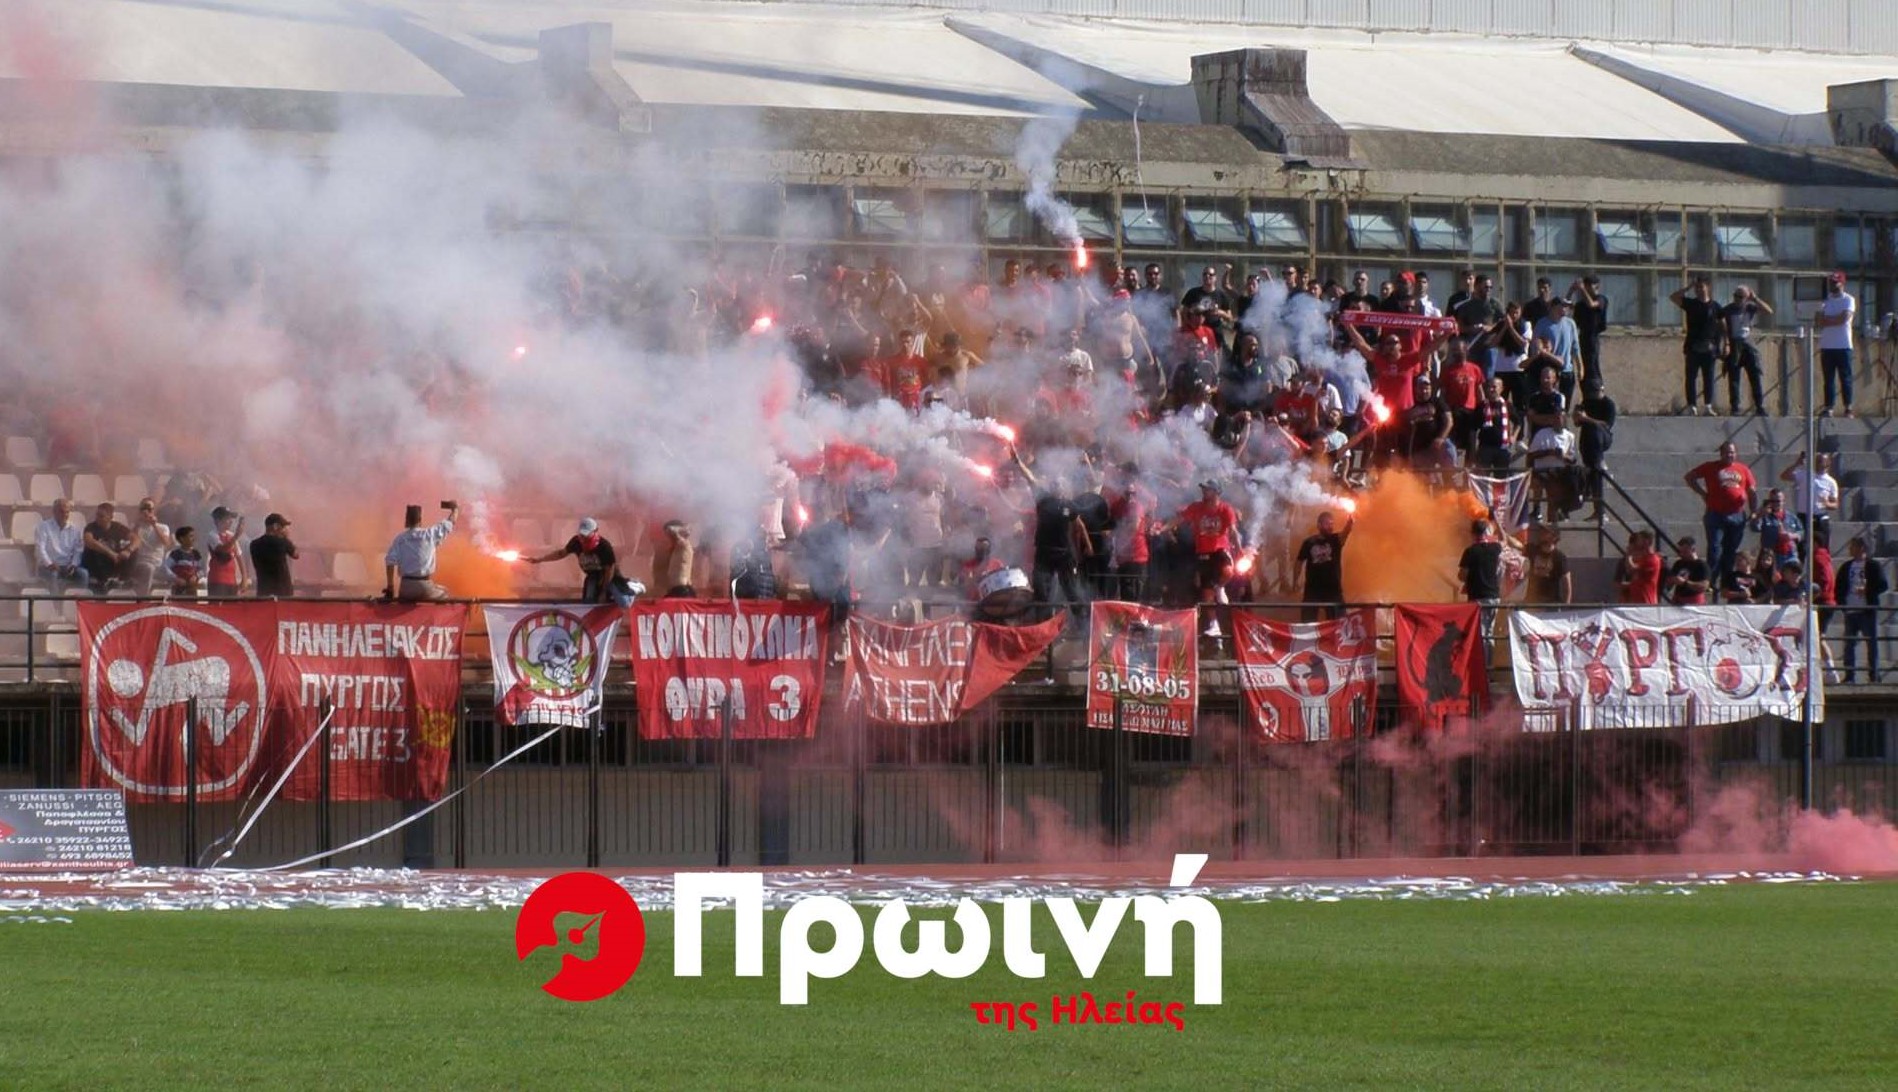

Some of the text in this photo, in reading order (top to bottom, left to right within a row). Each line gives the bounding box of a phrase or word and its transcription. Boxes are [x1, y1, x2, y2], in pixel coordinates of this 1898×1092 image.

[277, 620, 460, 660] ΠΑΝΗΛΕΙΑΚΟΣ
[301, 672, 406, 712] ΠΥΡΓΟΣ
[665, 674, 801, 722] ΘΥΡΑ 3
[1095, 671, 1190, 700] 31-08-05
[329, 726, 412, 763] GATE 3
[9, 793, 122, 802] SIEMENS PITSOS
[18, 802, 123, 810] ZANUSSI AEG
[78, 825, 129, 833] ΠΥΡΓΟΣ
